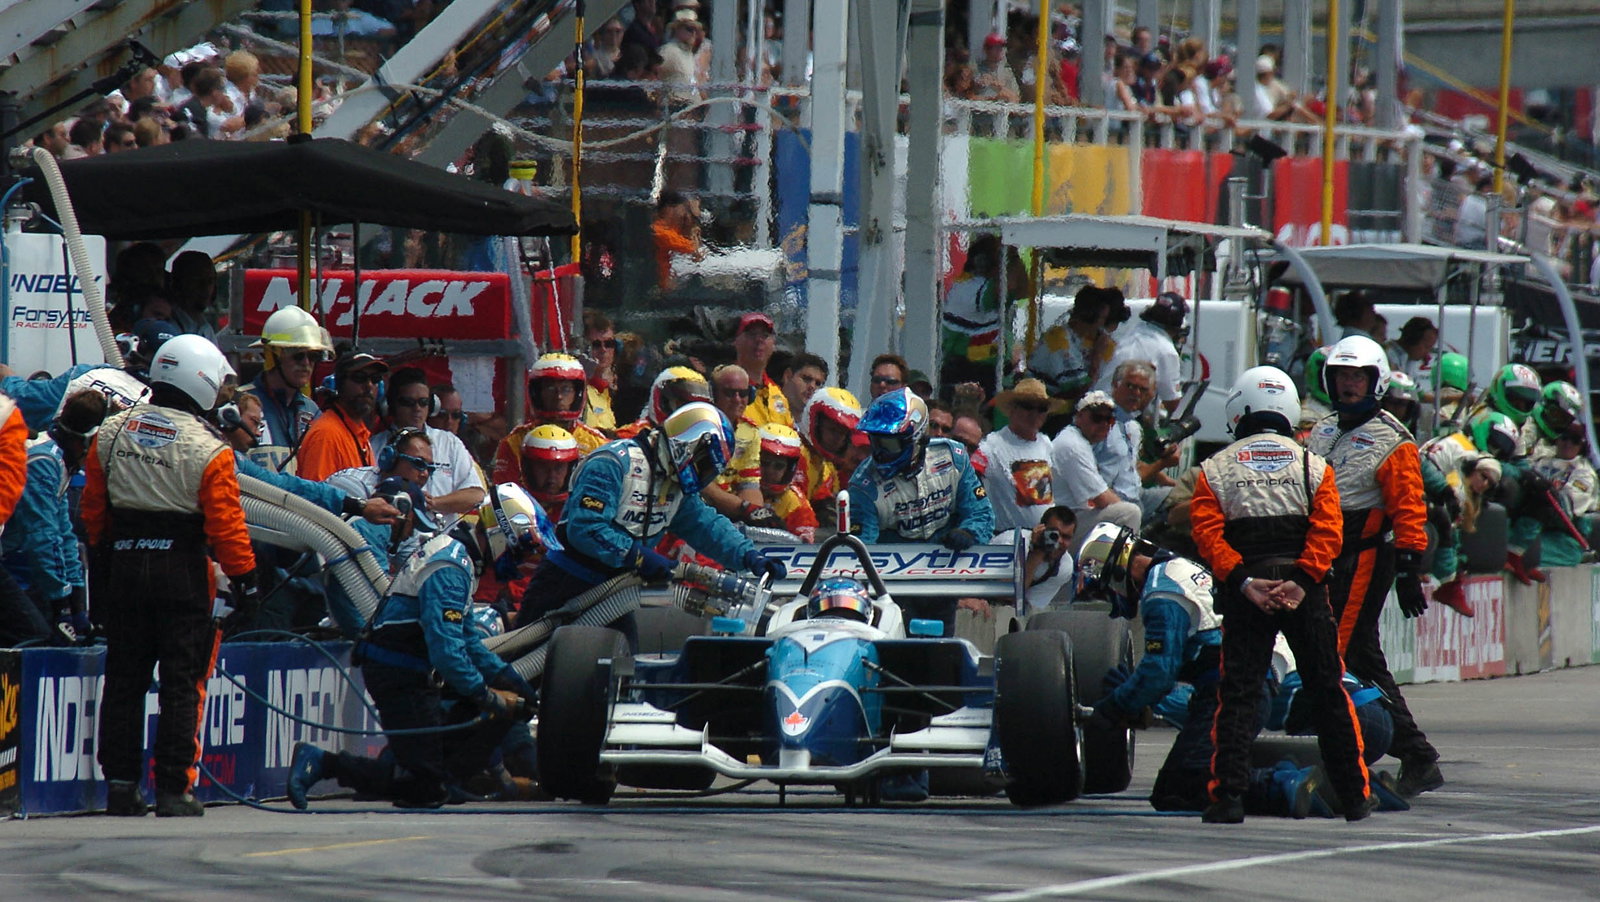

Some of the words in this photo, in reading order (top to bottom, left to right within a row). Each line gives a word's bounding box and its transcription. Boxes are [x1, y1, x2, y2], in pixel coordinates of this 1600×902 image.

[11, 274, 102, 293] INDEC
[116, 450, 172, 469] OFFICIAL
[1236, 478, 1300, 488] OFFICIAL
[760, 547, 1015, 574] Forsythe
[265, 667, 351, 768] INDECK
